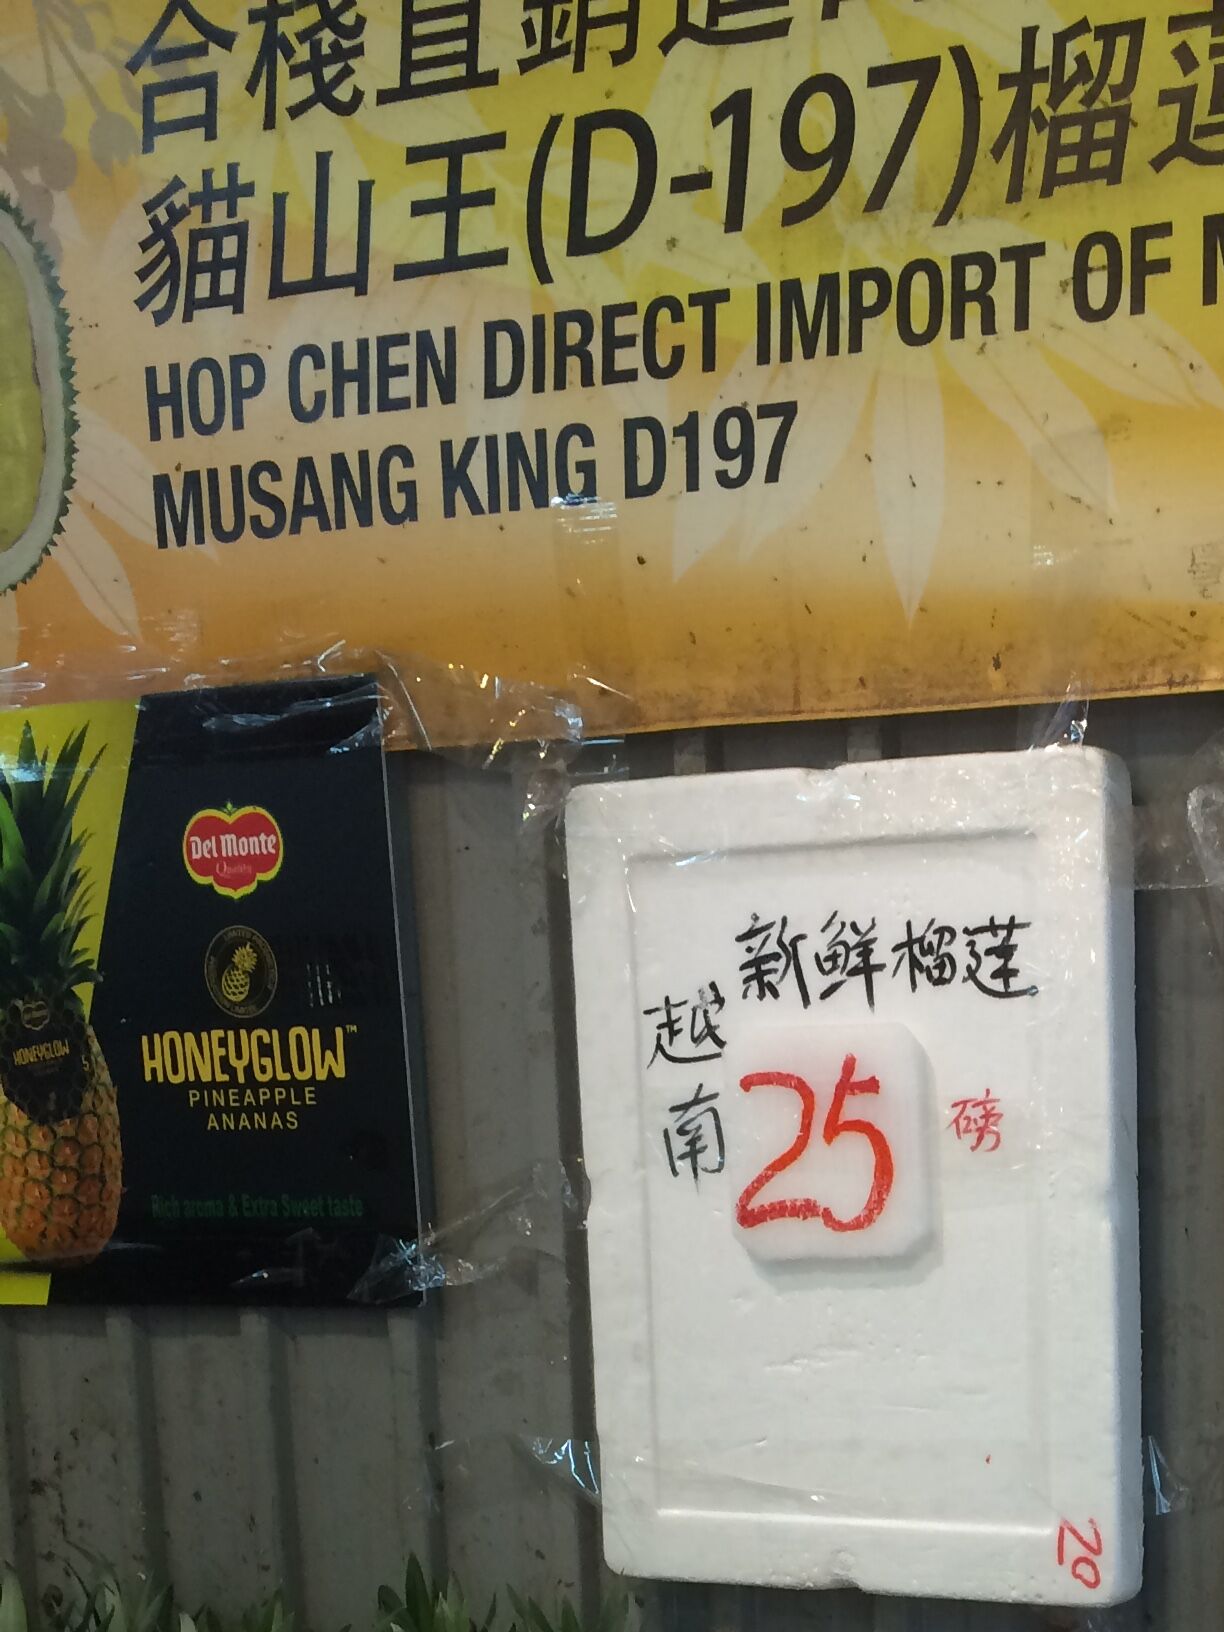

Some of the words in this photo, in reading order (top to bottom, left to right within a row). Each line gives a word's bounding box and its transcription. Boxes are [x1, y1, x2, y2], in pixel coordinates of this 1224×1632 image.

[145, 355, 266, 443] HOP
[287, 325, 459, 425] CHEN
[483, 287, 729, 399] DIRECT
[755, 241, 1046, 366] IMPORT
[1071, 221, 1174, 324] OF
[153, 443, 419, 550] MUSANG
[440, 423, 599, 519] KING
[623, 400, 799, 500] D197
[189, 835, 218, 860] Del
[219, 832, 277, 858] Monte
[188, 1086, 317, 1107] PINEAPPLE
[207, 1111, 299, 1130] ANANAS
[644, 980, 726, 1192] 越南
[946, 1087, 1005, 1154] 磅
[735, 1052, 896, 1234] 25
